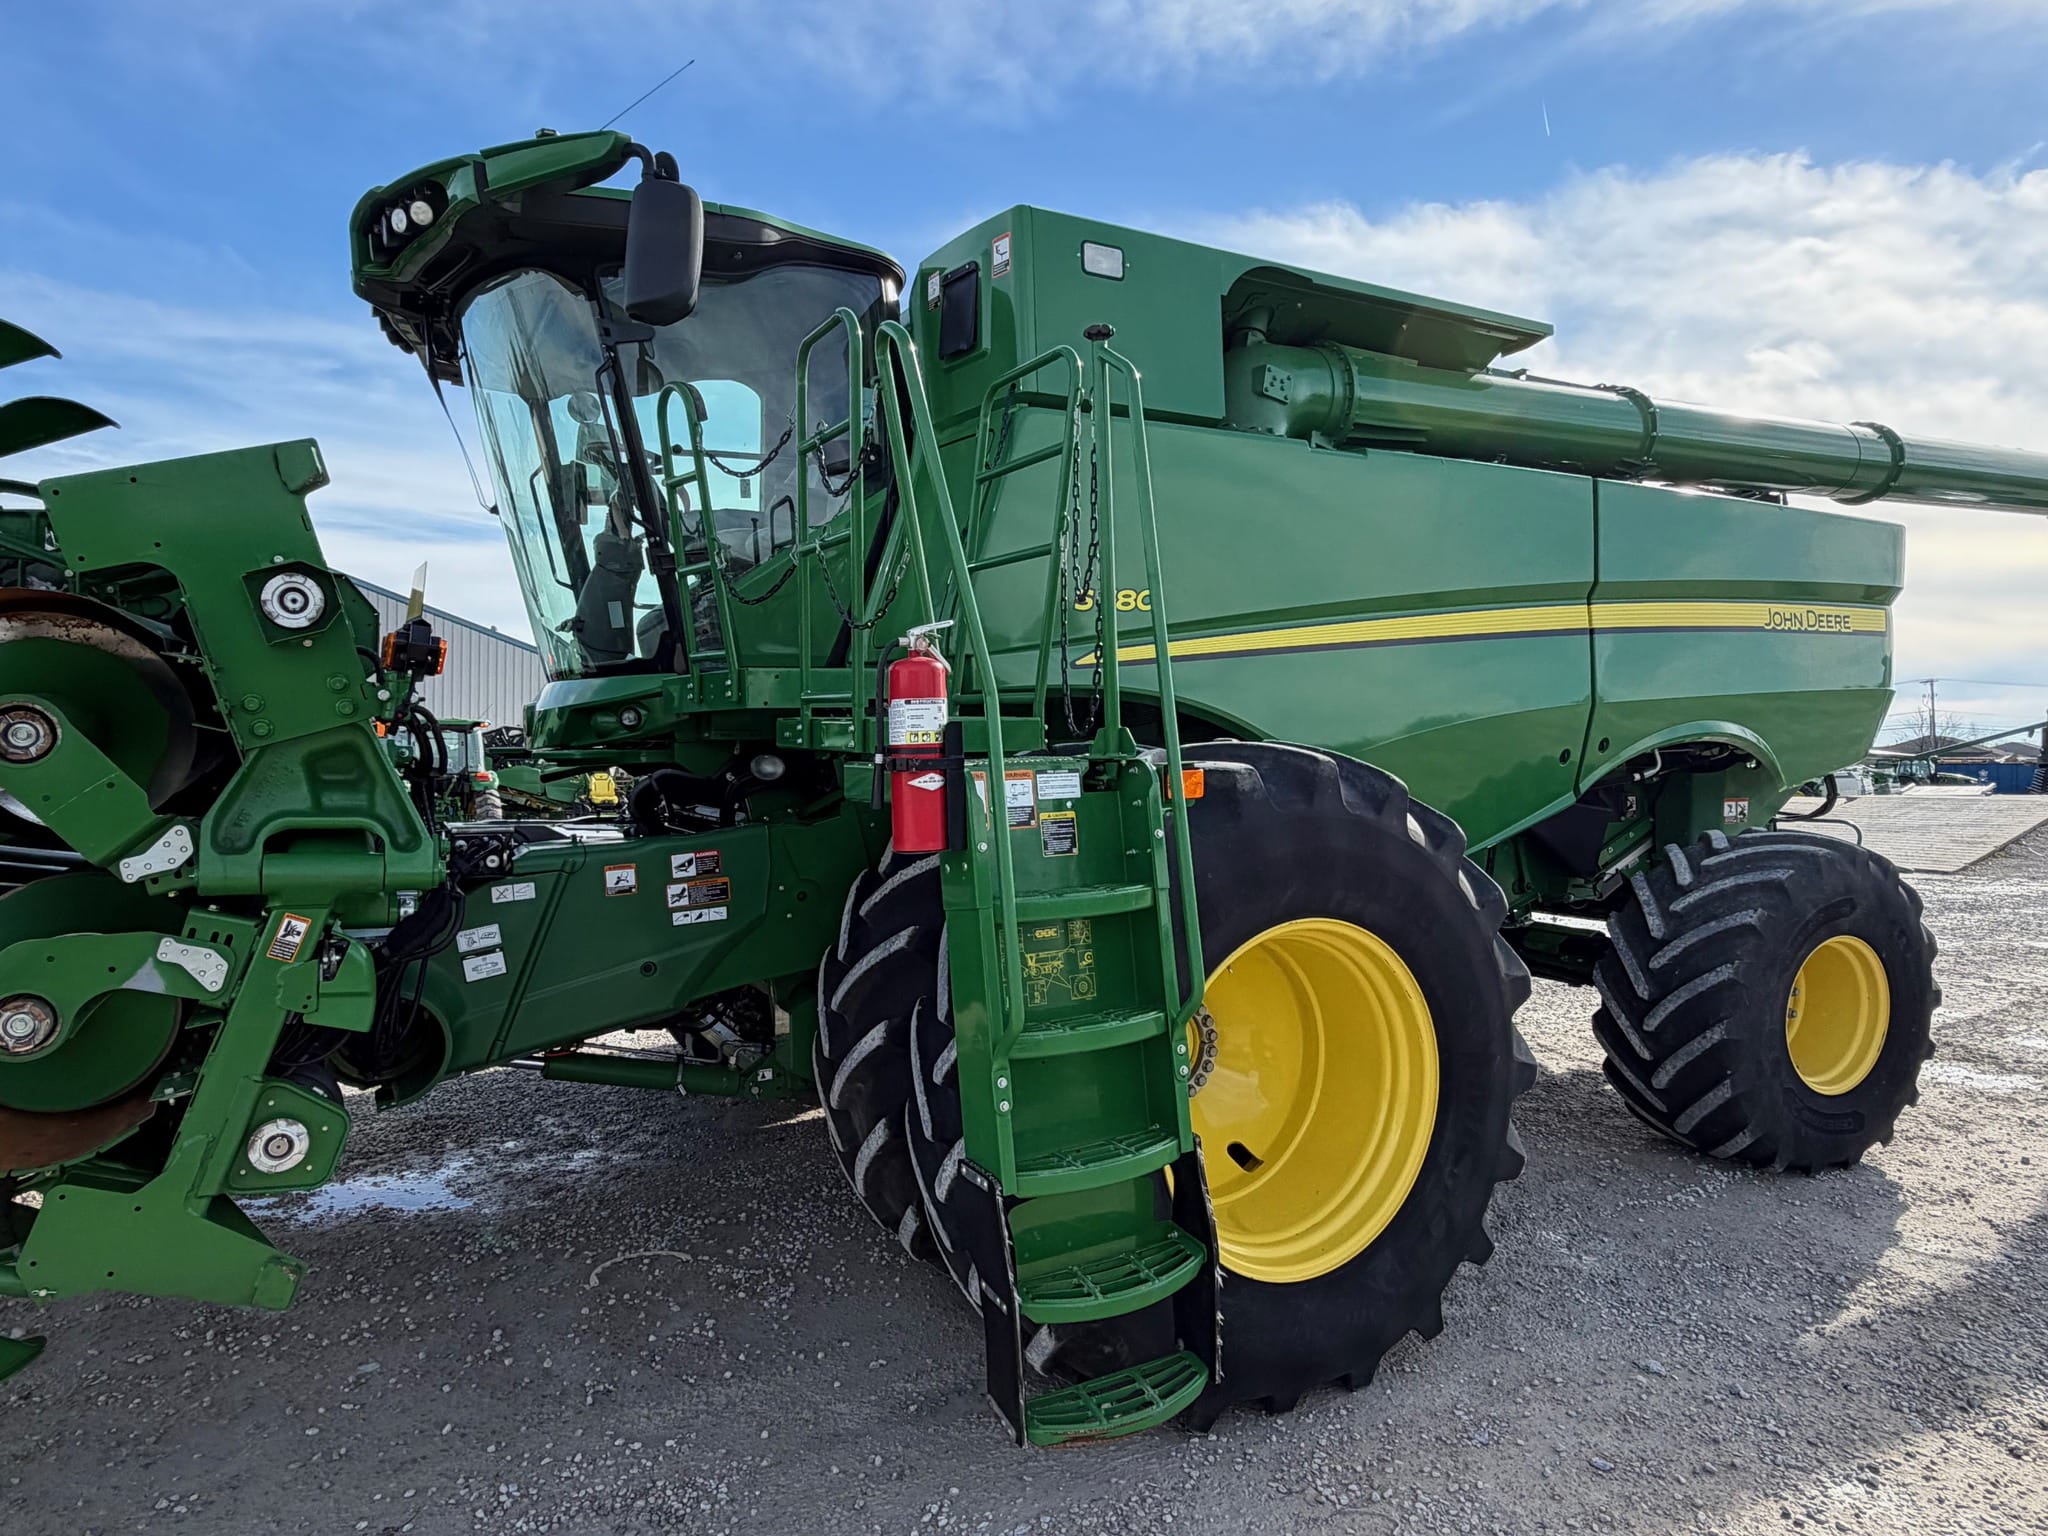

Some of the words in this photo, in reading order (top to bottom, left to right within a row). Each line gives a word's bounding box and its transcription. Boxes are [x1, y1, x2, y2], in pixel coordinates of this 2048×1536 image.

[1074, 588, 1152, 611] S80
[1764, 608, 1803, 628] JOHN
[1806, 610, 1851, 630] DEERE
